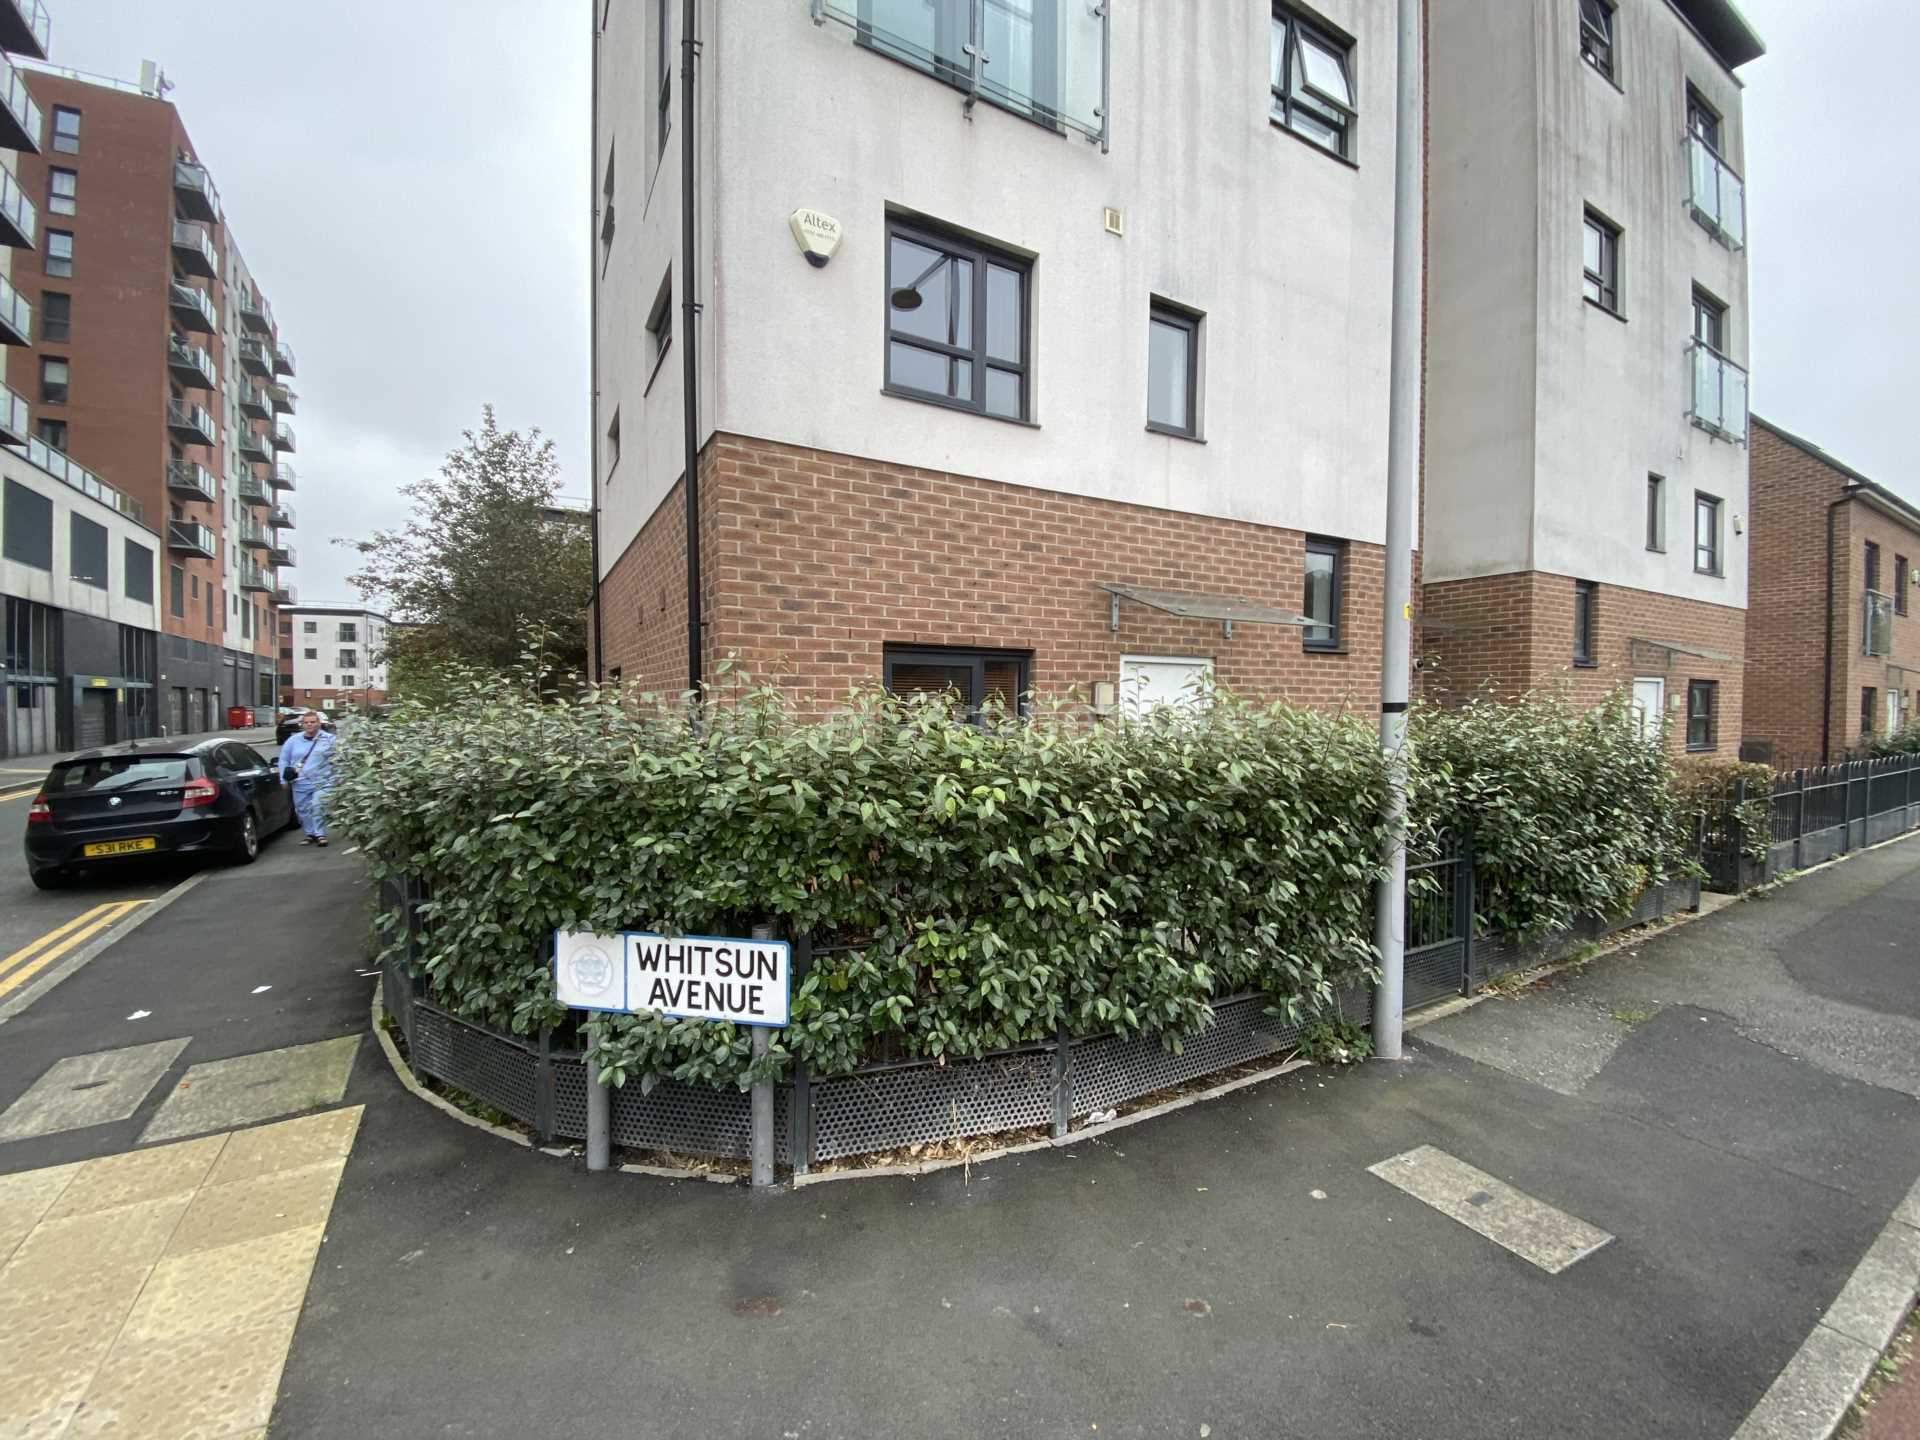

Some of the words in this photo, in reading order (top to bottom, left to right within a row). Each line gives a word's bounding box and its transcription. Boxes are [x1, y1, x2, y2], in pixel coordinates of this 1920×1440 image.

[804, 213, 836, 233] Altex
[119, 840, 144, 851] RKE
[635, 942, 778, 981] WHITSUN
[648, 978, 764, 1015] AVENUE
